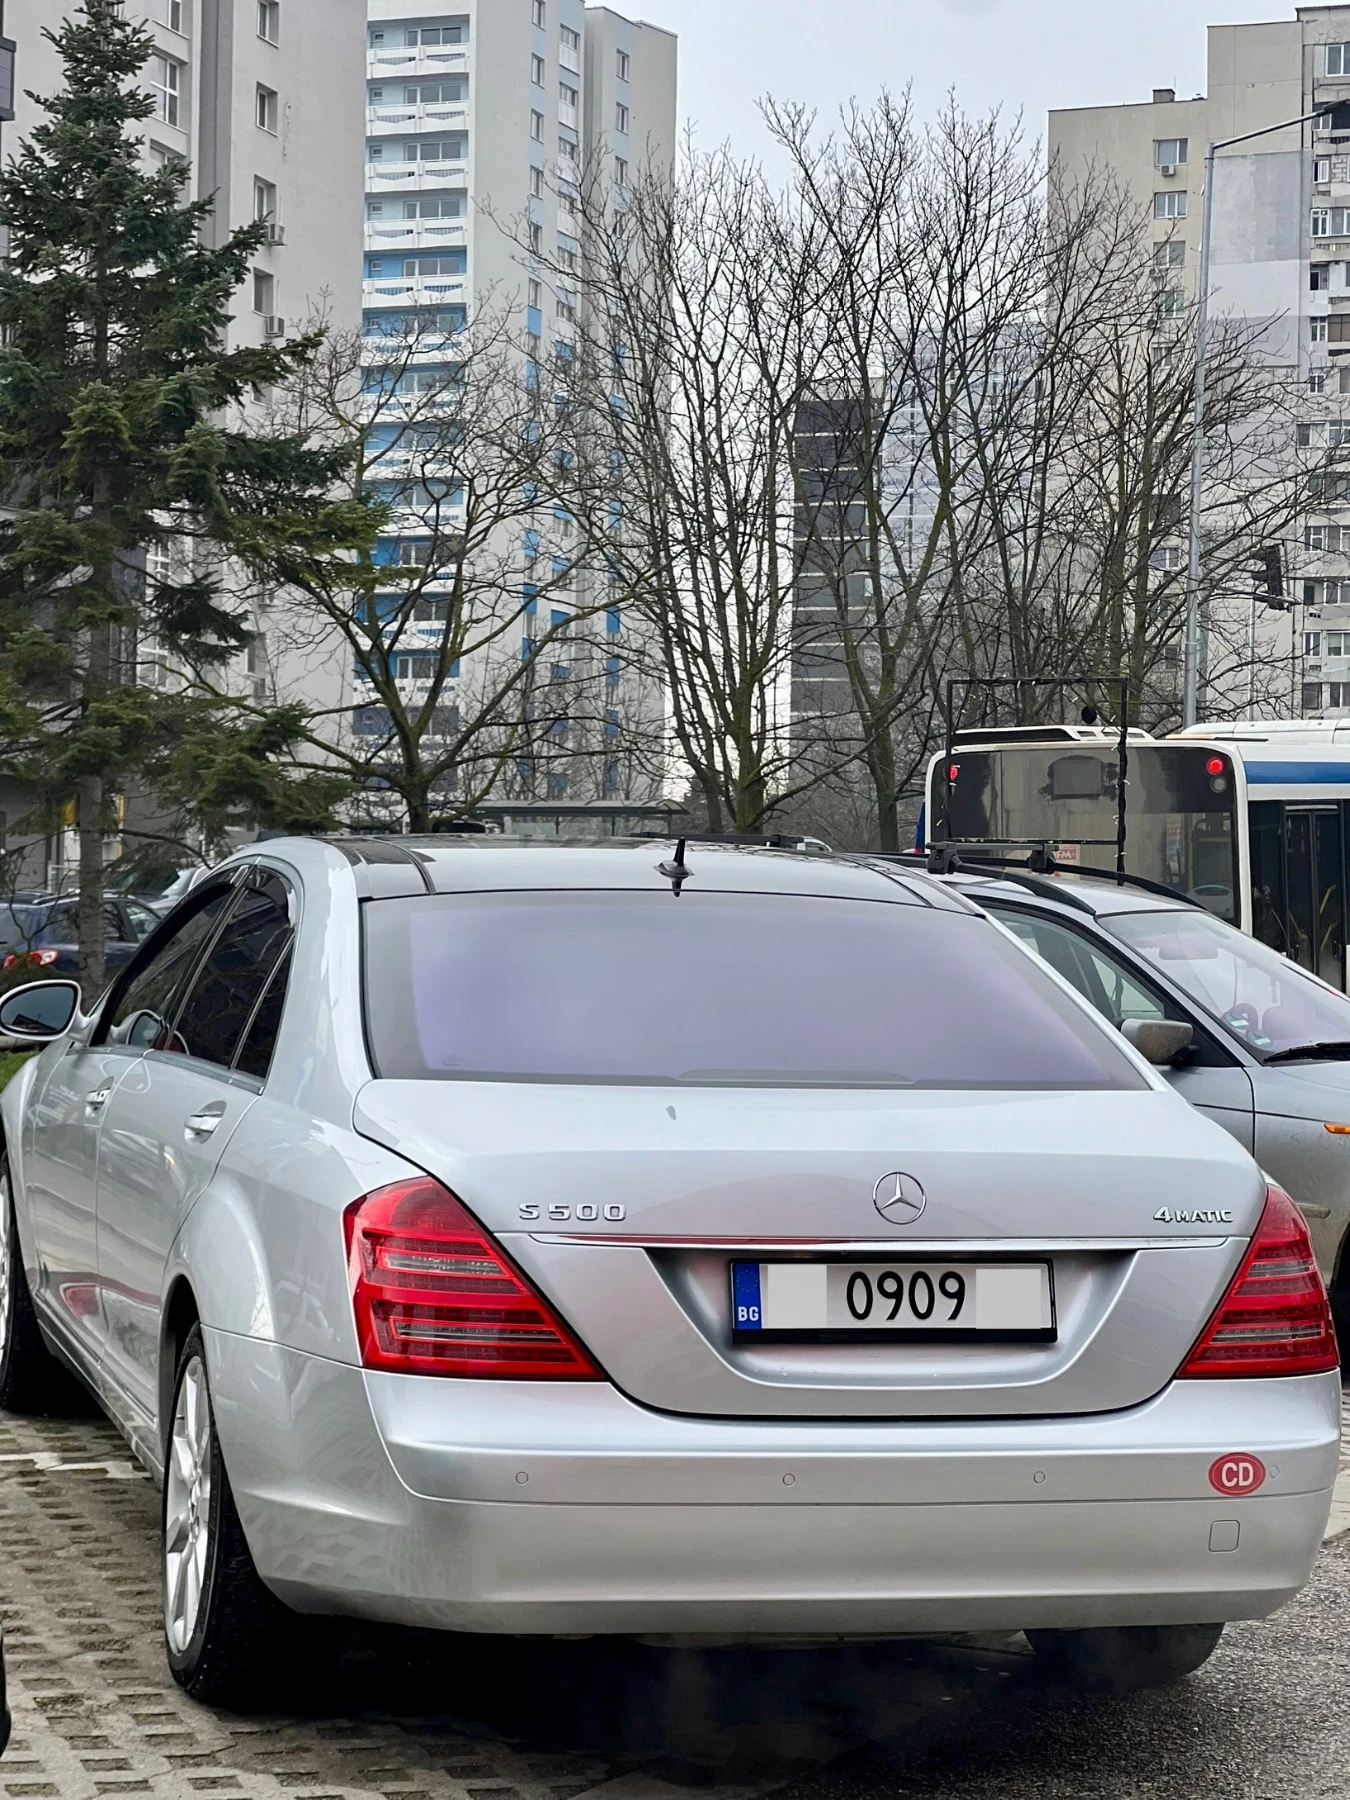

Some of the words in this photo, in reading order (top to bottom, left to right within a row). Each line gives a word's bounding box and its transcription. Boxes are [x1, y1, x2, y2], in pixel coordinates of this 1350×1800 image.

[846, 1270, 966, 1321] 0909
[737, 1306, 760, 1322] BG
[1221, 1462, 1254, 1487] CD
